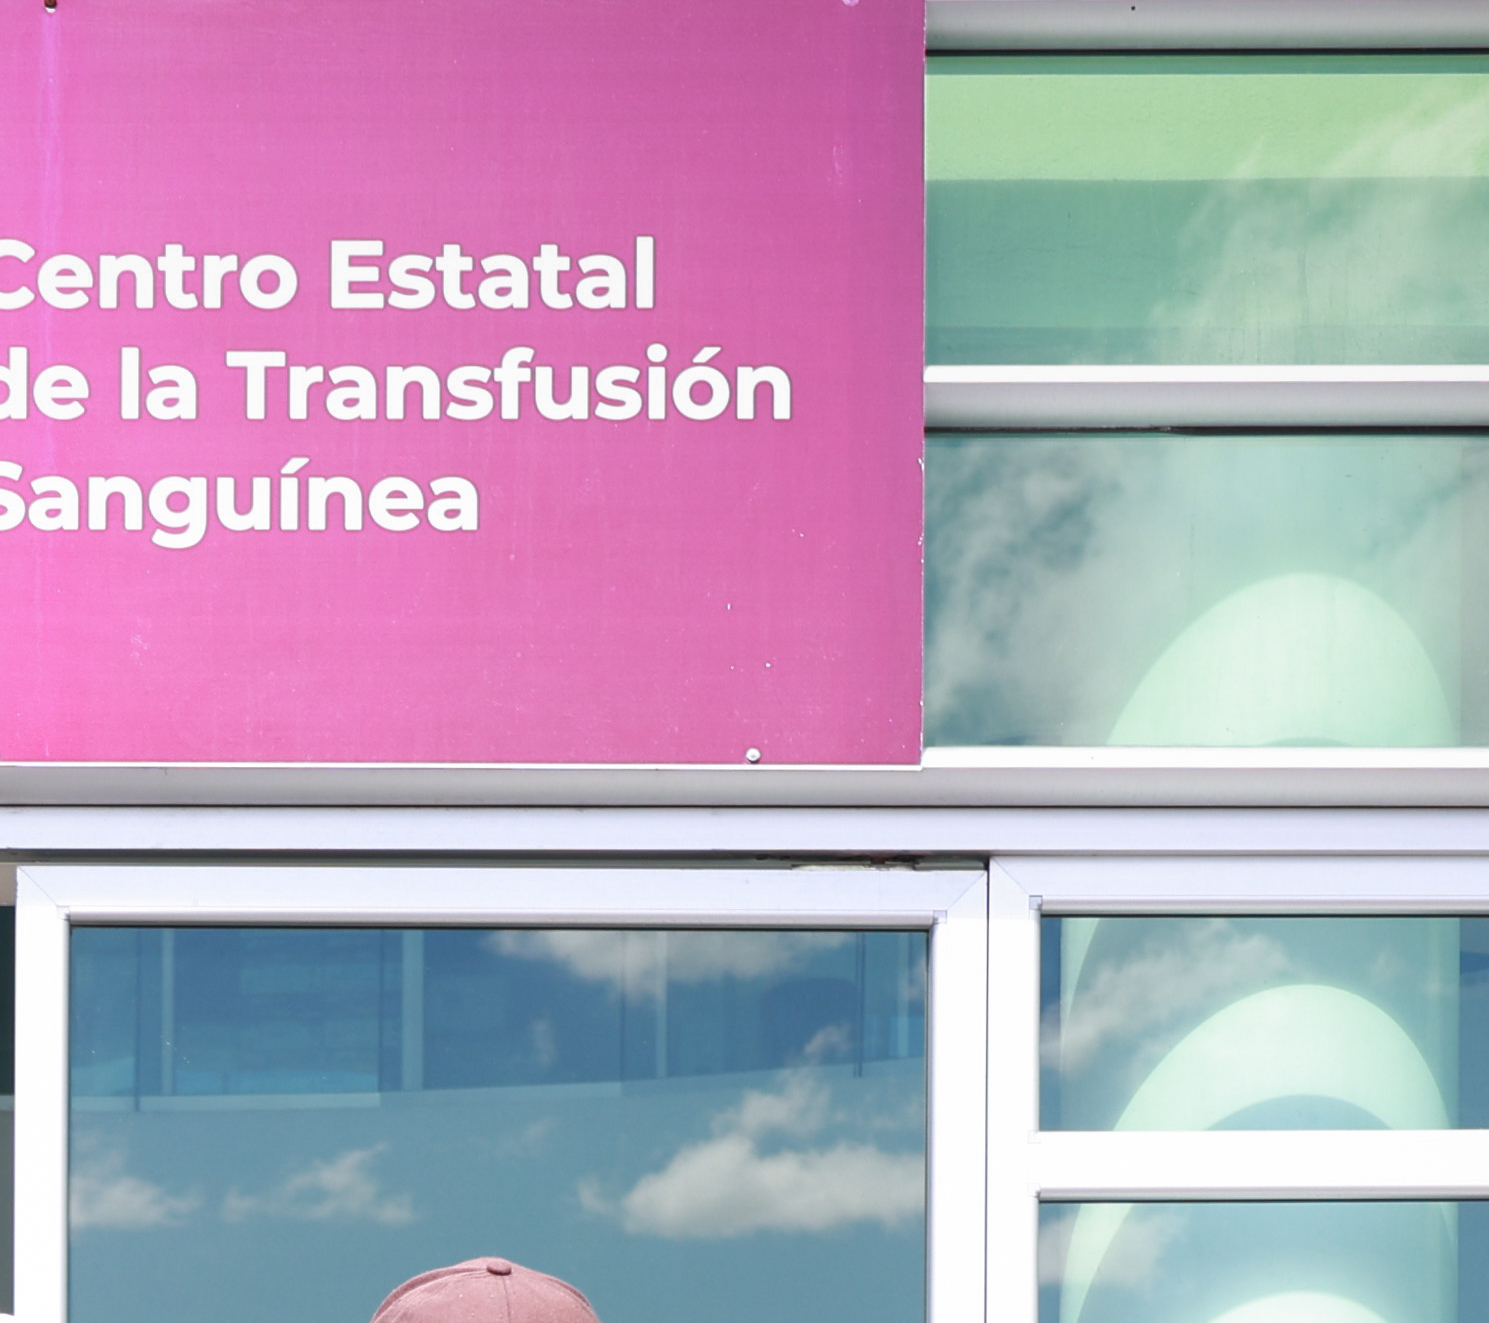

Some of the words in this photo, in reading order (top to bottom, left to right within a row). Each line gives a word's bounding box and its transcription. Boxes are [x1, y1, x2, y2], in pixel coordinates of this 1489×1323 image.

[330, 235, 655, 311] Estatal
[120, 345, 198, 421] la
[225, 342, 792, 422] Transfusión
